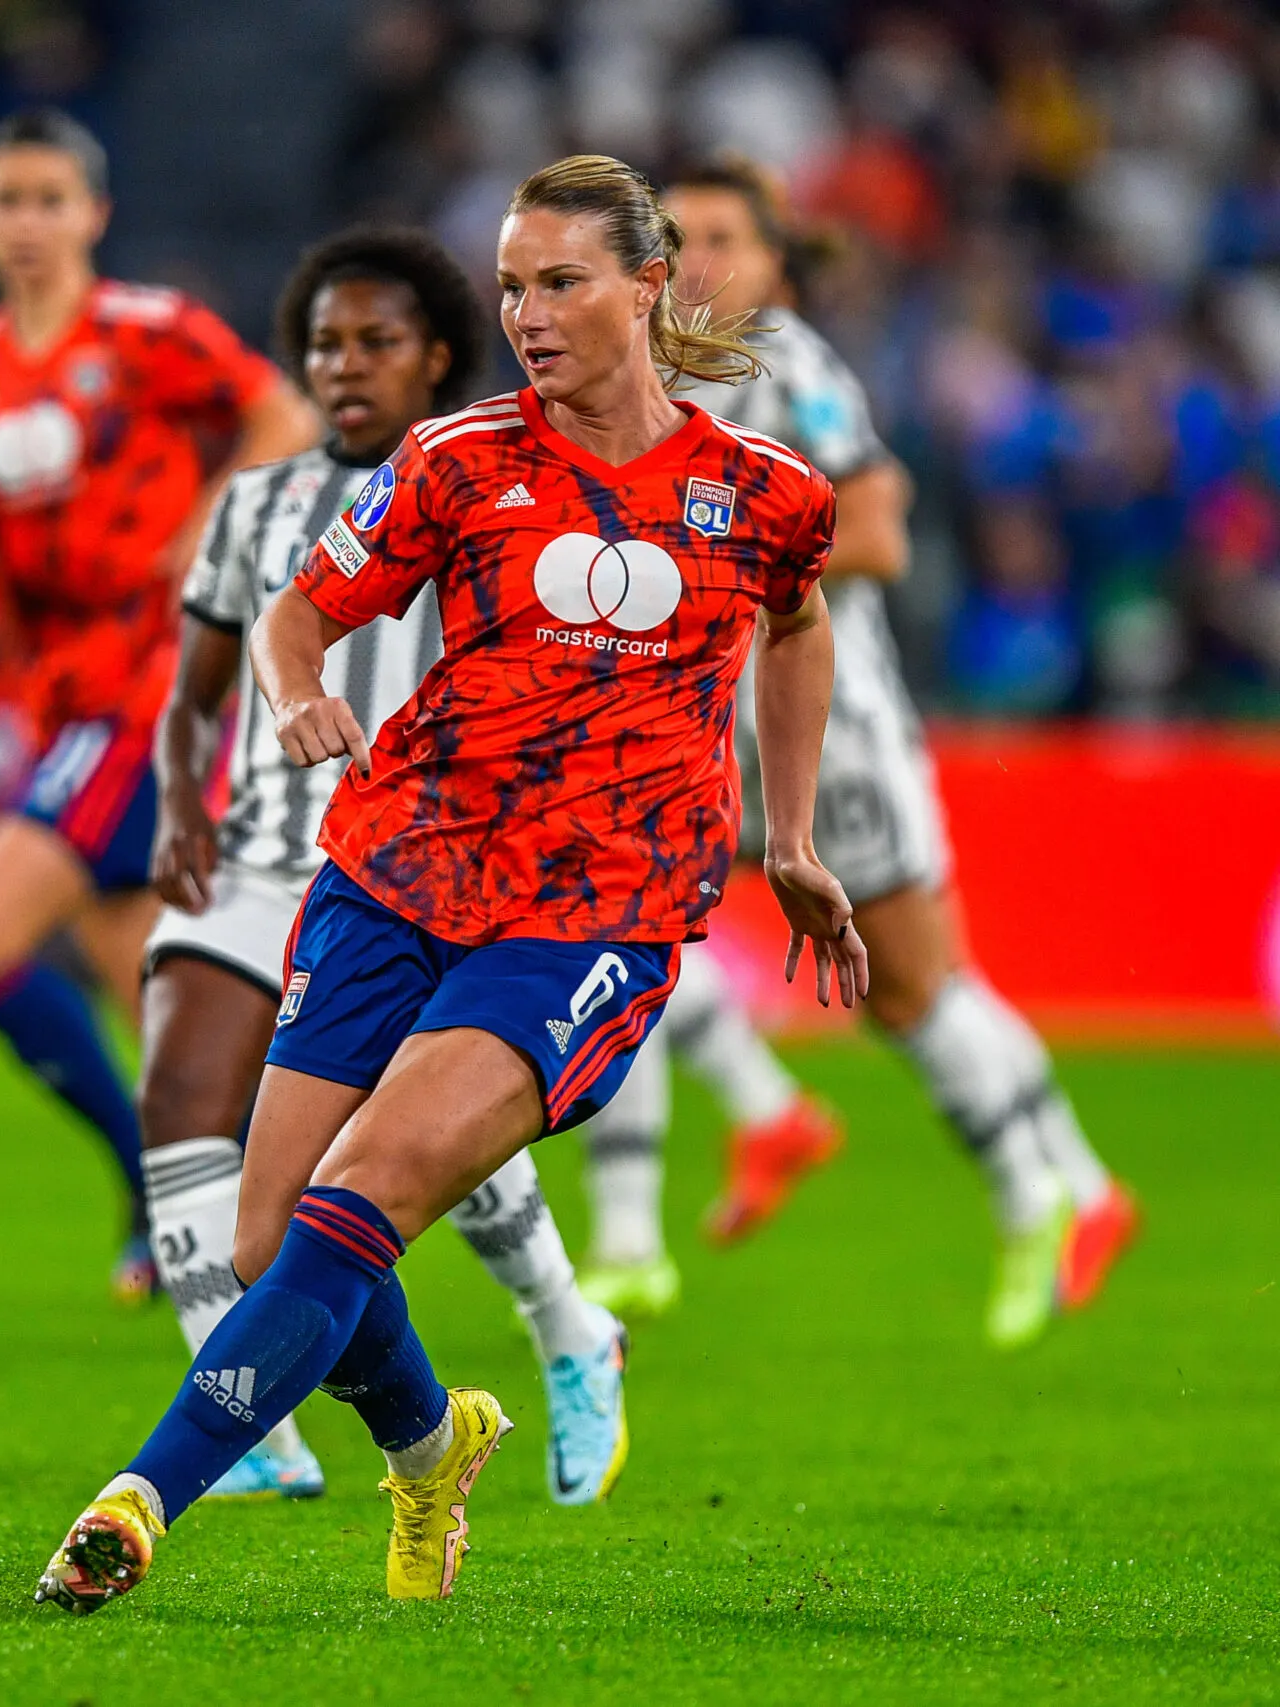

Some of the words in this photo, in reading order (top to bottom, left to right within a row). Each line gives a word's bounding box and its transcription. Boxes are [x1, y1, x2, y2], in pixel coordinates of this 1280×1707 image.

[495, 497, 536, 509] adidas
[691, 489, 731, 505] LYONNAIS
[692, 483, 732, 498] OLYMPIQUE
[535, 626, 669, 658] mastercard
[569, 951, 629, 1027] 6
[545, 1019, 568, 1055] adidas
[193, 1370, 256, 1423] adidas
